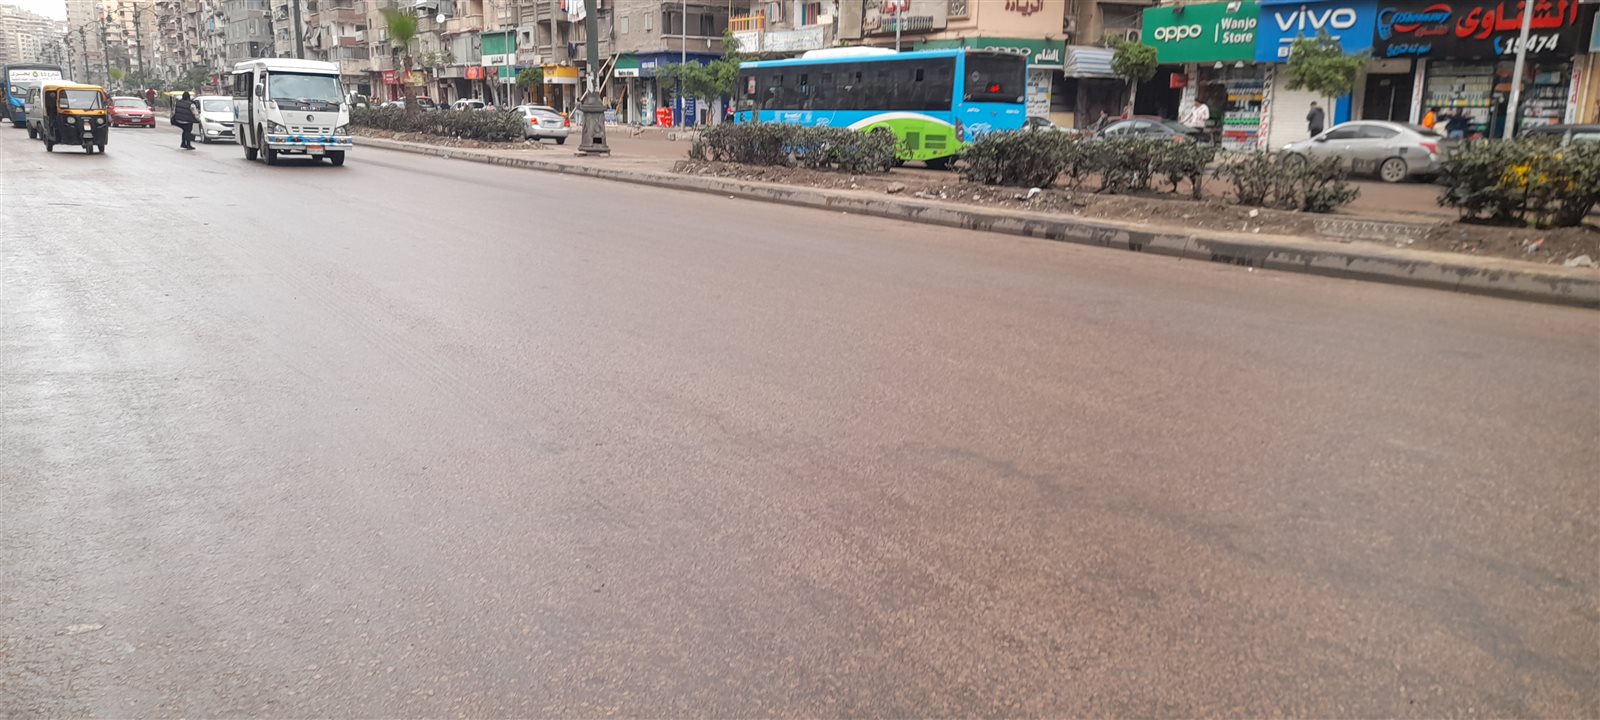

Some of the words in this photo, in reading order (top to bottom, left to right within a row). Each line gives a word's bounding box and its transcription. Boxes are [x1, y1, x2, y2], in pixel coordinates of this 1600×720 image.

[1221, 17, 1257, 31] Wanjo
[1154, 24, 1202, 41] oppo
[1222, 31, 1253, 43] Store
[1034, 48, 1059, 63] الشام
